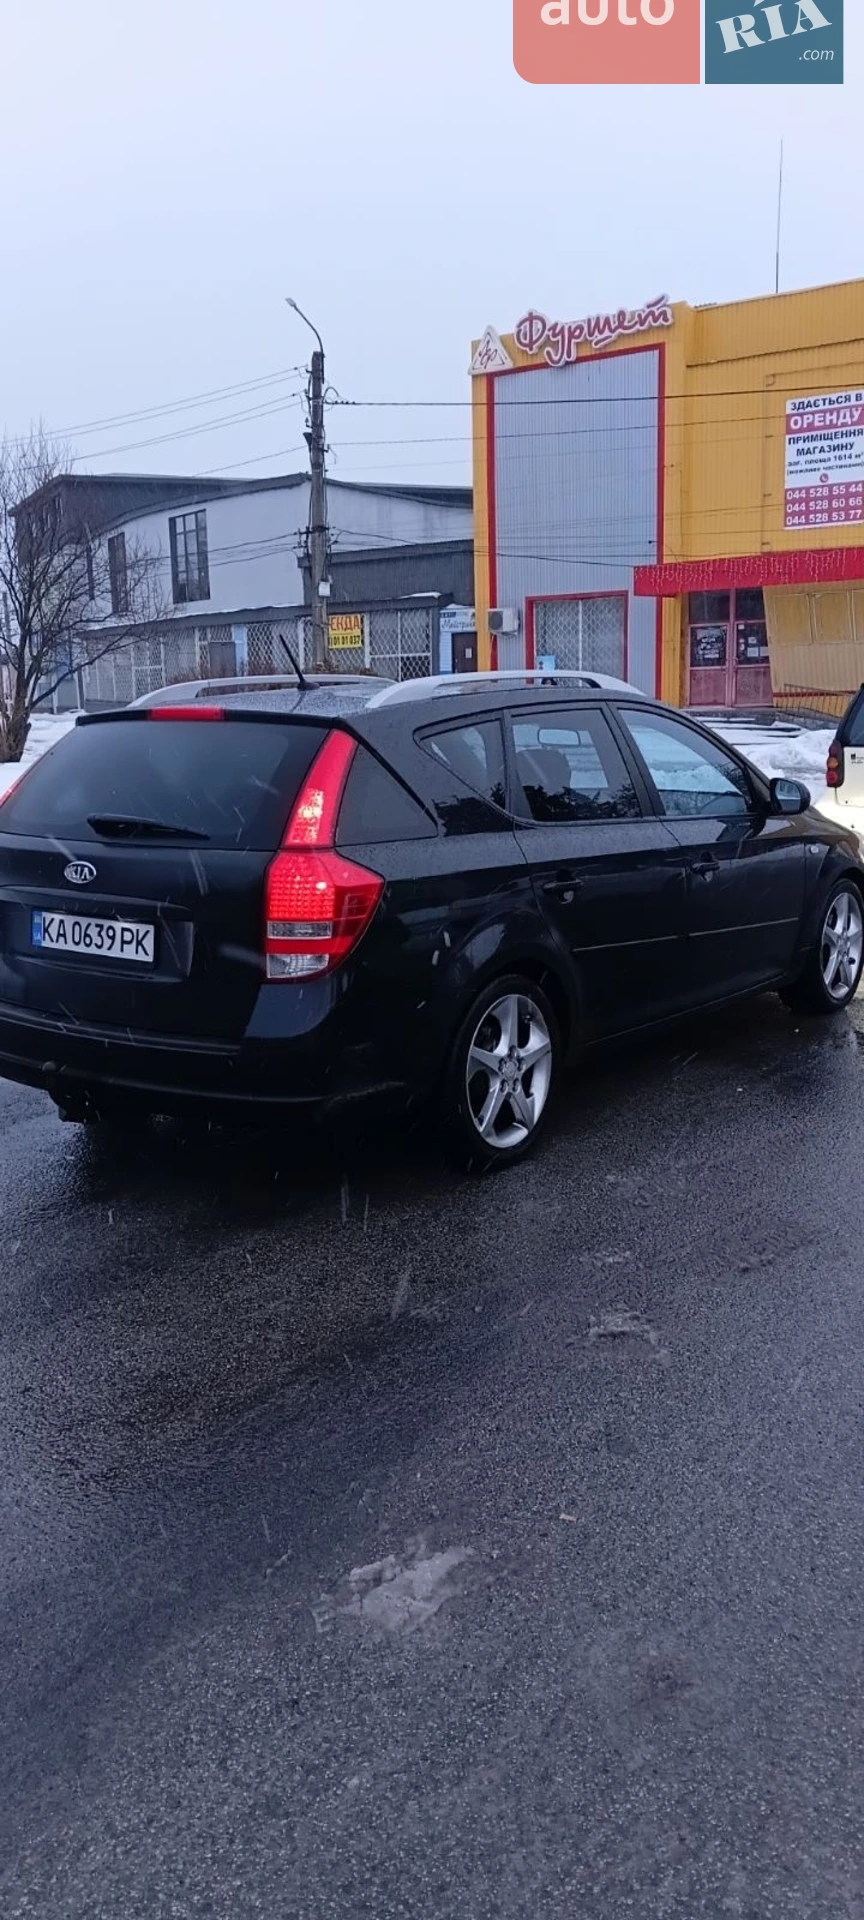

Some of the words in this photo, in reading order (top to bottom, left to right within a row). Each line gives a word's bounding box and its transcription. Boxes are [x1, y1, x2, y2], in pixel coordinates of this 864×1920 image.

[515, 294, 671, 365] Фуршет
[790, 395, 852, 412] ЗДАЄТЬСЯ
[855, 393, 863, 402] В
[790, 407, 863, 430] ОРЕНДУ
[788, 428, 864, 445] ПРИМІЩЕННЯ
[796, 441, 855, 457] МАГАЗИНУ
[786, 489, 806, 500] 044
[809, 487, 829, 498] 528
[832, 485, 846, 495] 55
[849, 483, 863, 493] 44
[786, 502, 806, 513] 044
[809, 500, 829, 510] 528
[832, 498, 846, 508] 60
[786, 515, 806, 526] 044
[809, 513, 829, 523] 528
[832, 510, 846, 521] 53
[849, 508, 863, 519] 77
[330, 615, 360, 631] ЕНДА
[65, 864, 92, 881] KIA
[42, 916, 68, 945] KA
[71, 920, 116, 951] 0639
[120, 927, 151, 956] PK
